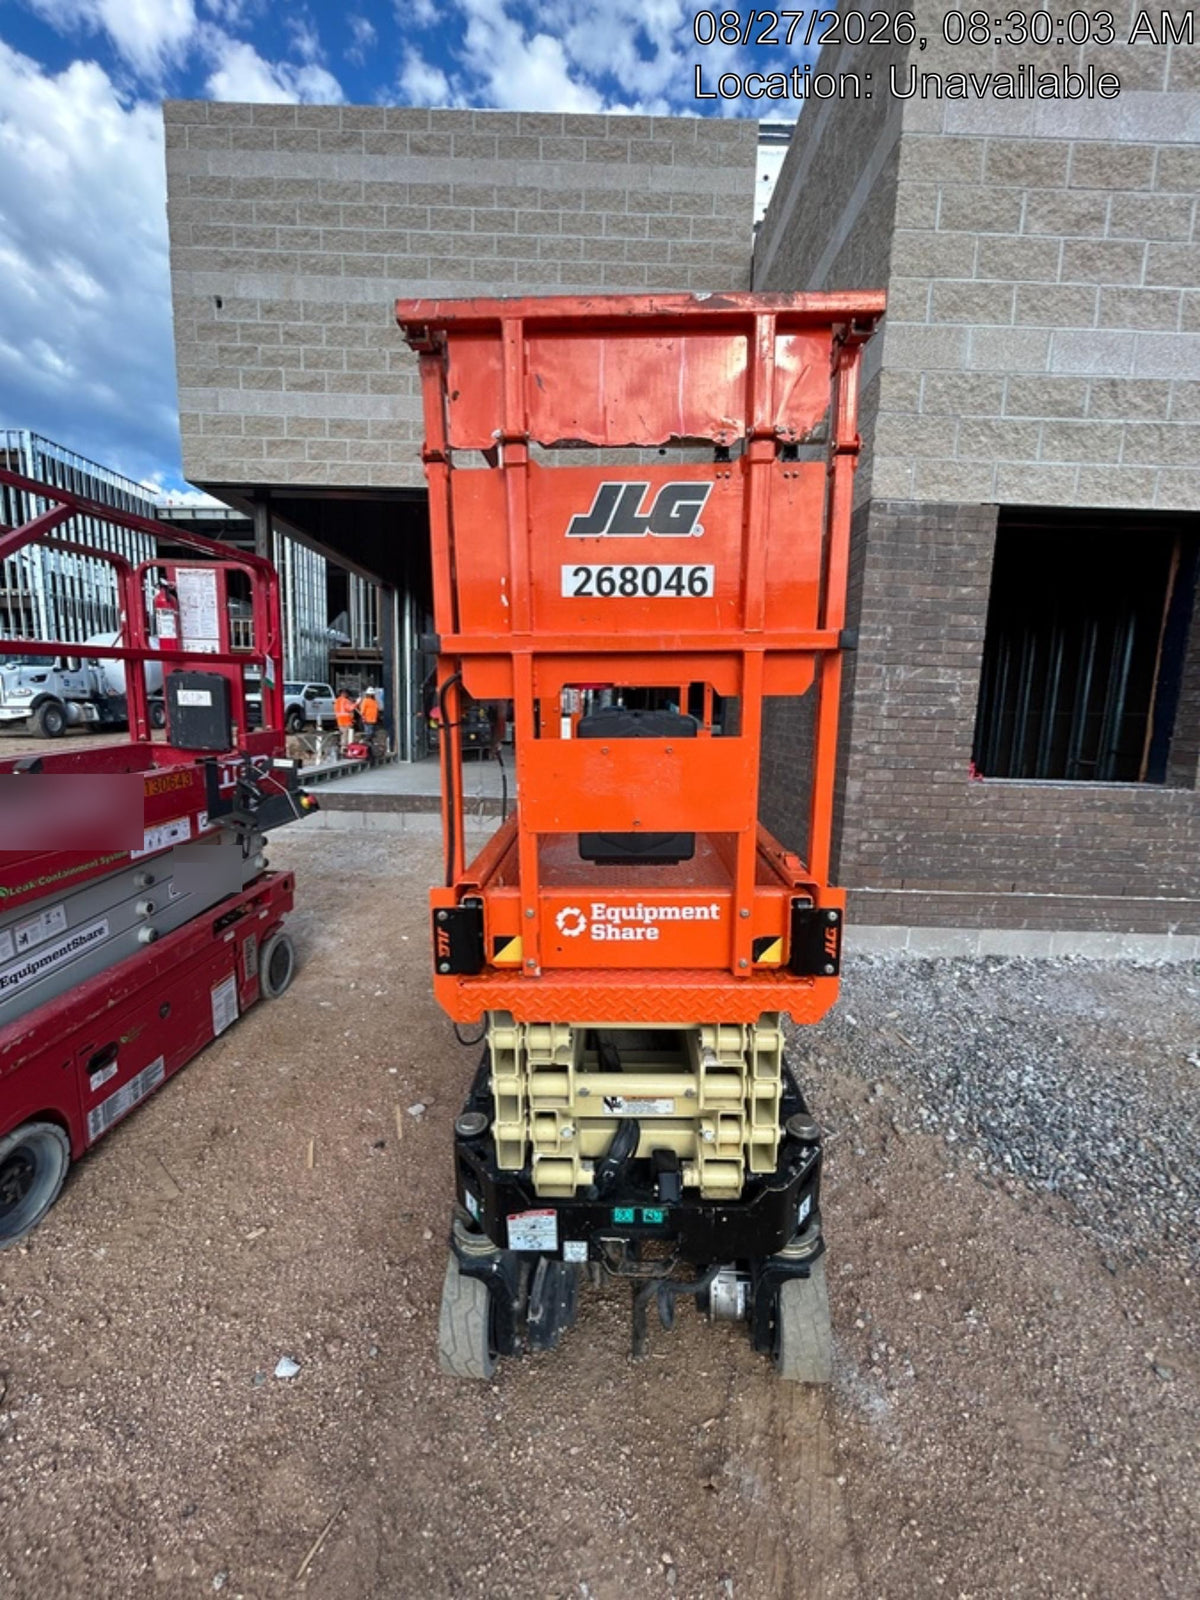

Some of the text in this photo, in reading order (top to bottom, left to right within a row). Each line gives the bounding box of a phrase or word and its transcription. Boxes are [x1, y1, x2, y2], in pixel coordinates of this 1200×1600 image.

[565, 482, 714, 538] JLG
[572, 566, 708, 597] 268046
[9, 882, 36, 896] Leak
[38, 859, 98, 886] Containment
[591, 903, 720, 924] Equipment
[437, 926, 451, 957] JLG
[591, 924, 659, 941] Share
[824, 926, 837, 959] JLG
[0, 926, 105, 989] EquipmentShare
